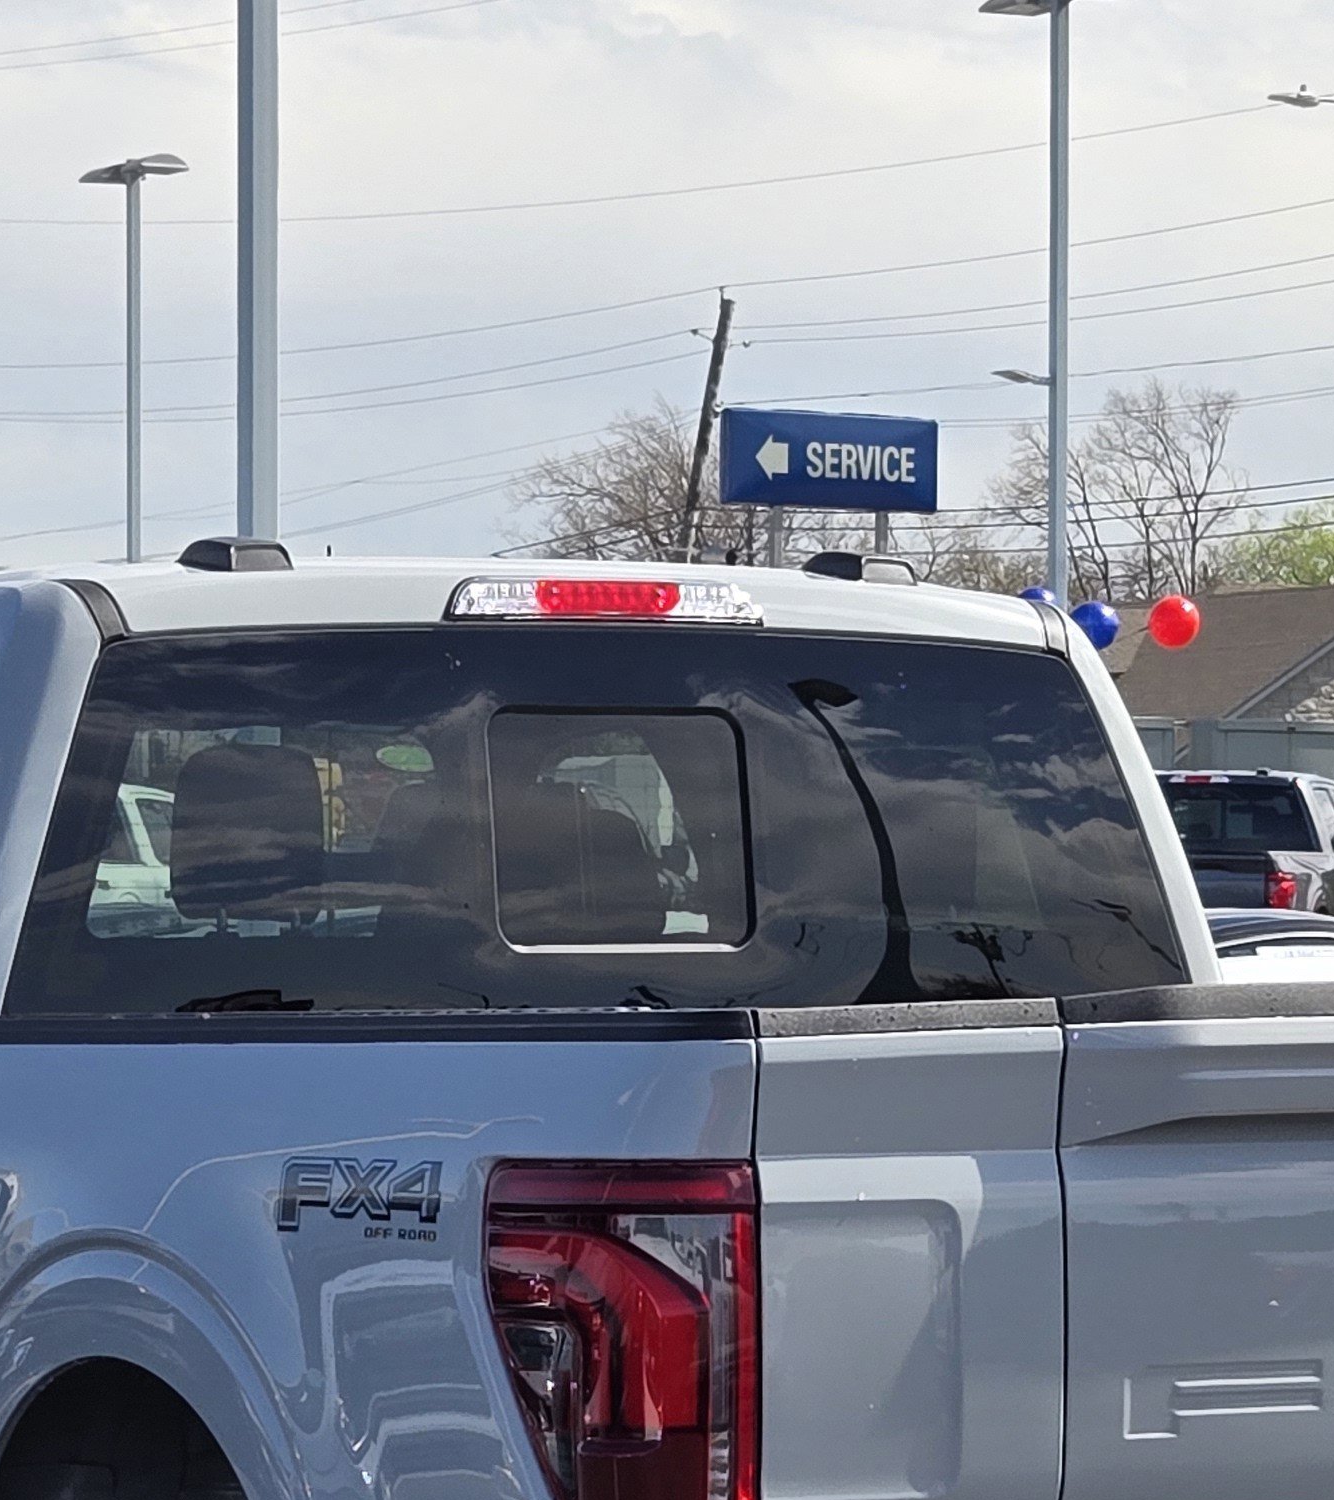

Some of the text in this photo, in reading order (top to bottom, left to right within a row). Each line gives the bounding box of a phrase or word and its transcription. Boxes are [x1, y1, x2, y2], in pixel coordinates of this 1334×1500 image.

[806, 441, 916, 483] SERVICE
[277, 1156, 443, 1232] FX4
[364, 1226, 437, 1242] OFF ROAD
